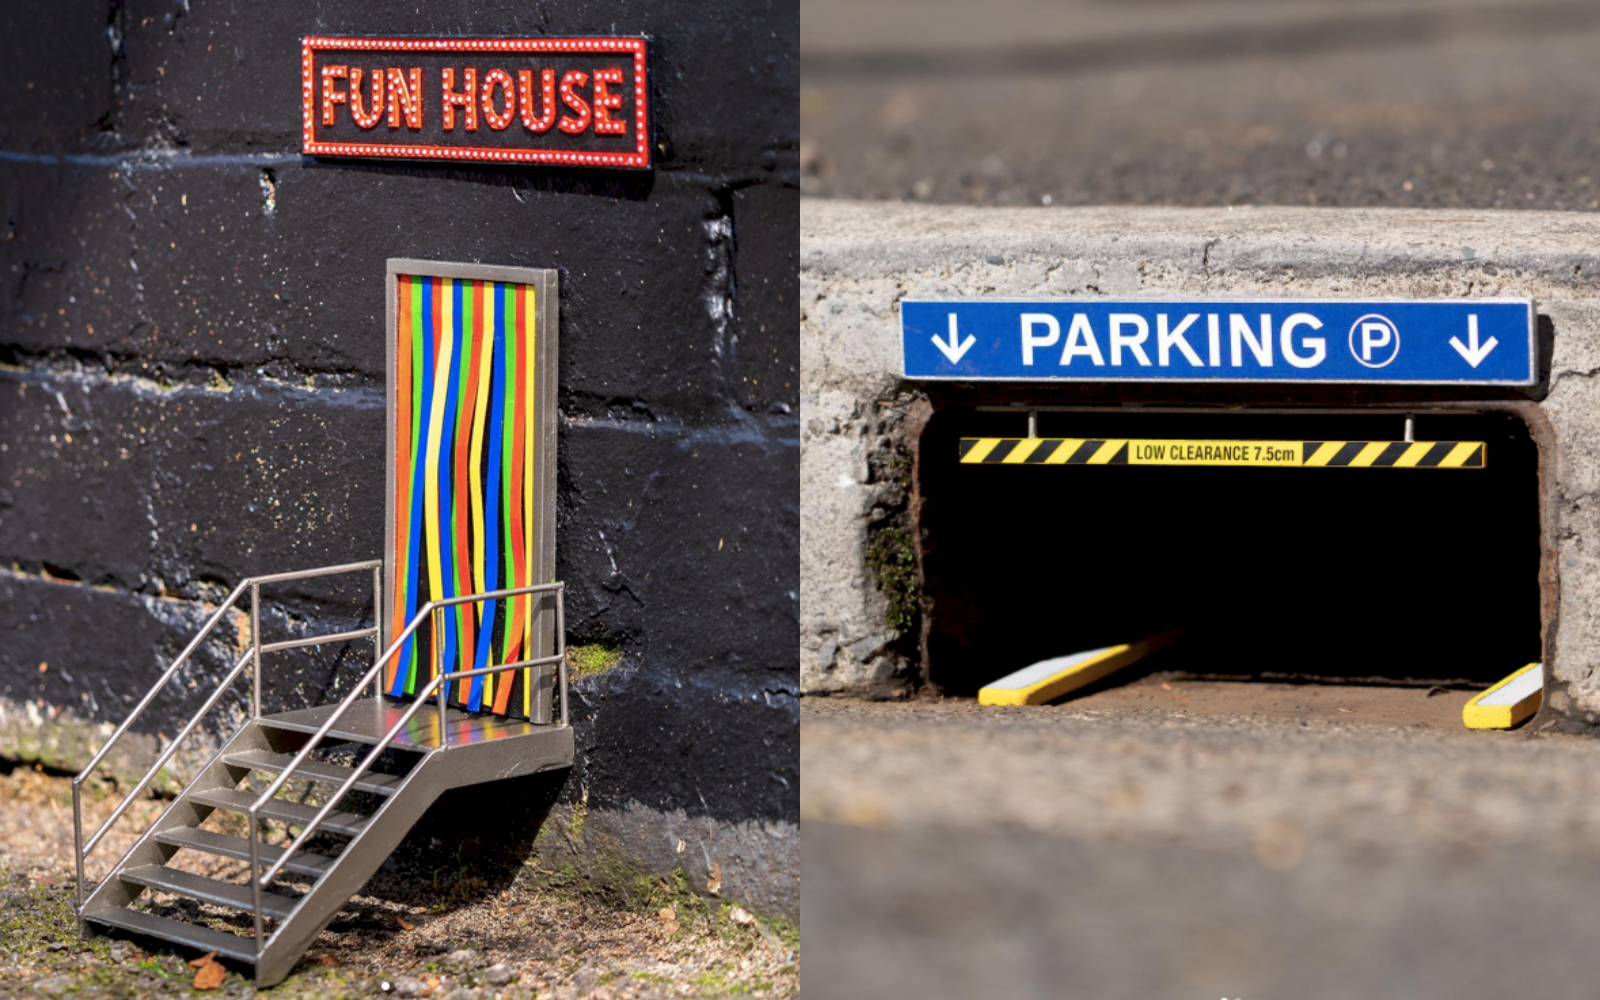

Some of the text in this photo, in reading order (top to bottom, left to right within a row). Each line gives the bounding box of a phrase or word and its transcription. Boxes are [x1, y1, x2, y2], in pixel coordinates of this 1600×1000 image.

[321, 65, 626, 135] FUN HOUSE
[1020, 313, 1327, 368] PARKING
[1136, 444, 1295, 461] LOW CLEARANCE 7.5cm
